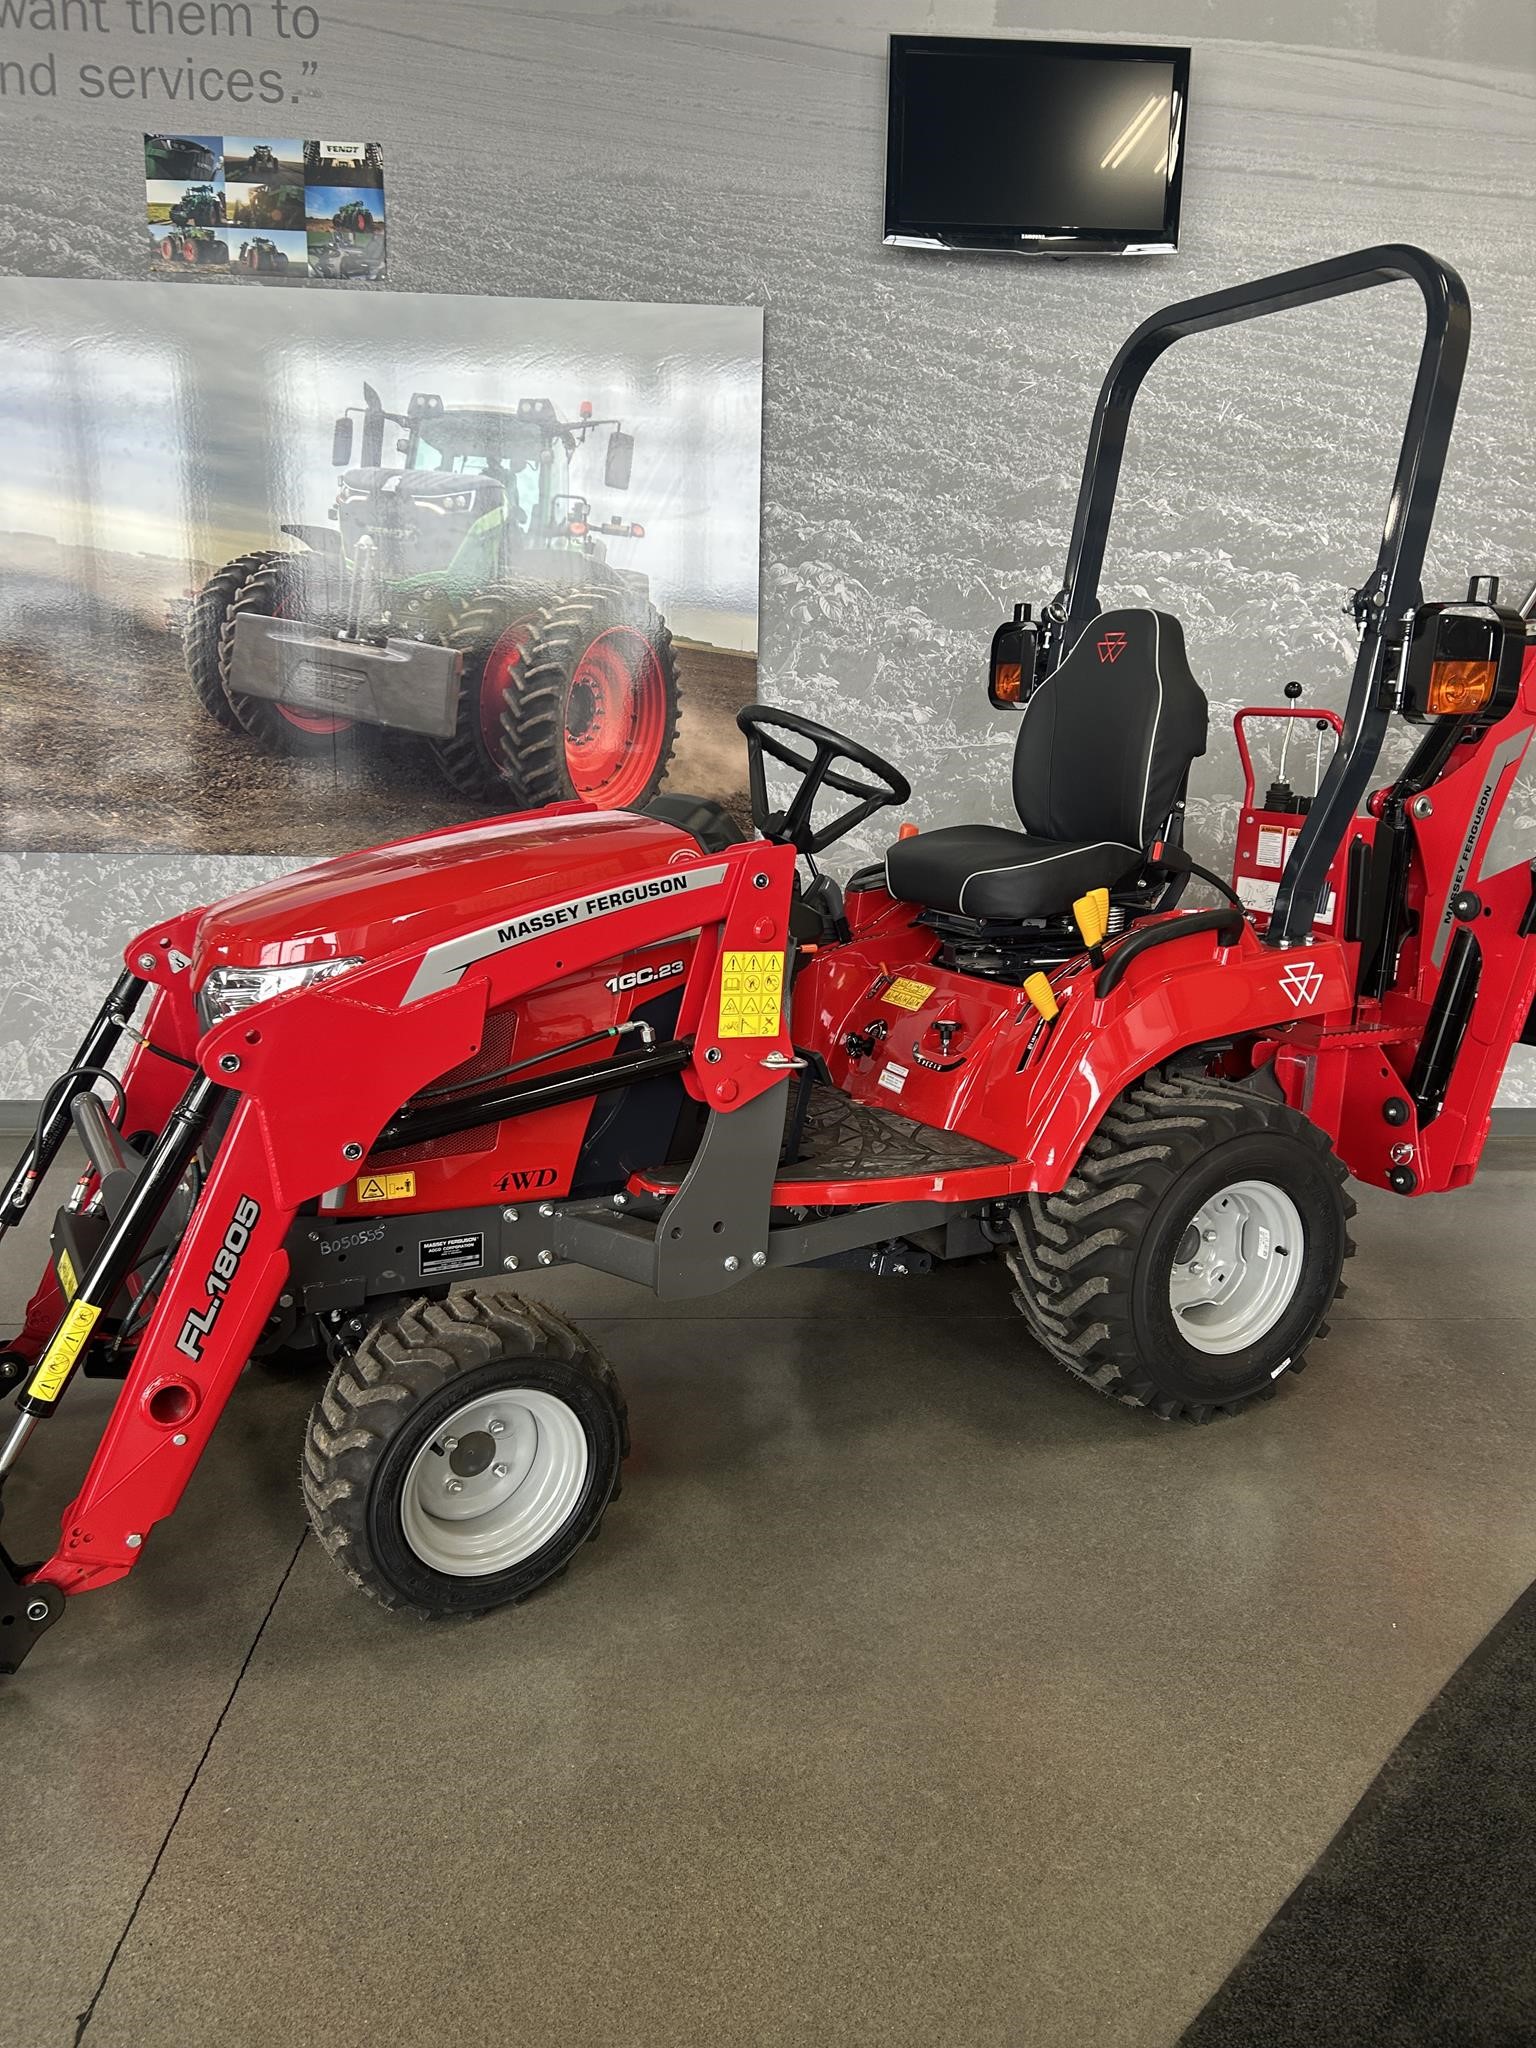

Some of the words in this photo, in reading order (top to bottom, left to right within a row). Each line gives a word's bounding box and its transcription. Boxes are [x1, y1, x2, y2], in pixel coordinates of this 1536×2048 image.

[126, 0, 252, 37] them
[271, 0, 320, 39] to
[1462, 784, 1492, 861] FERGUSON
[497, 904, 579, 943] MASSEY
[586, 875, 688, 915] FERGUSON
[604, 960, 685, 993] 1GC.23
[493, 1168, 558, 1192] 4WD
[423, 1241, 447, 1249] MASSEY
[177, 1194, 260, 1362] FL.1805
